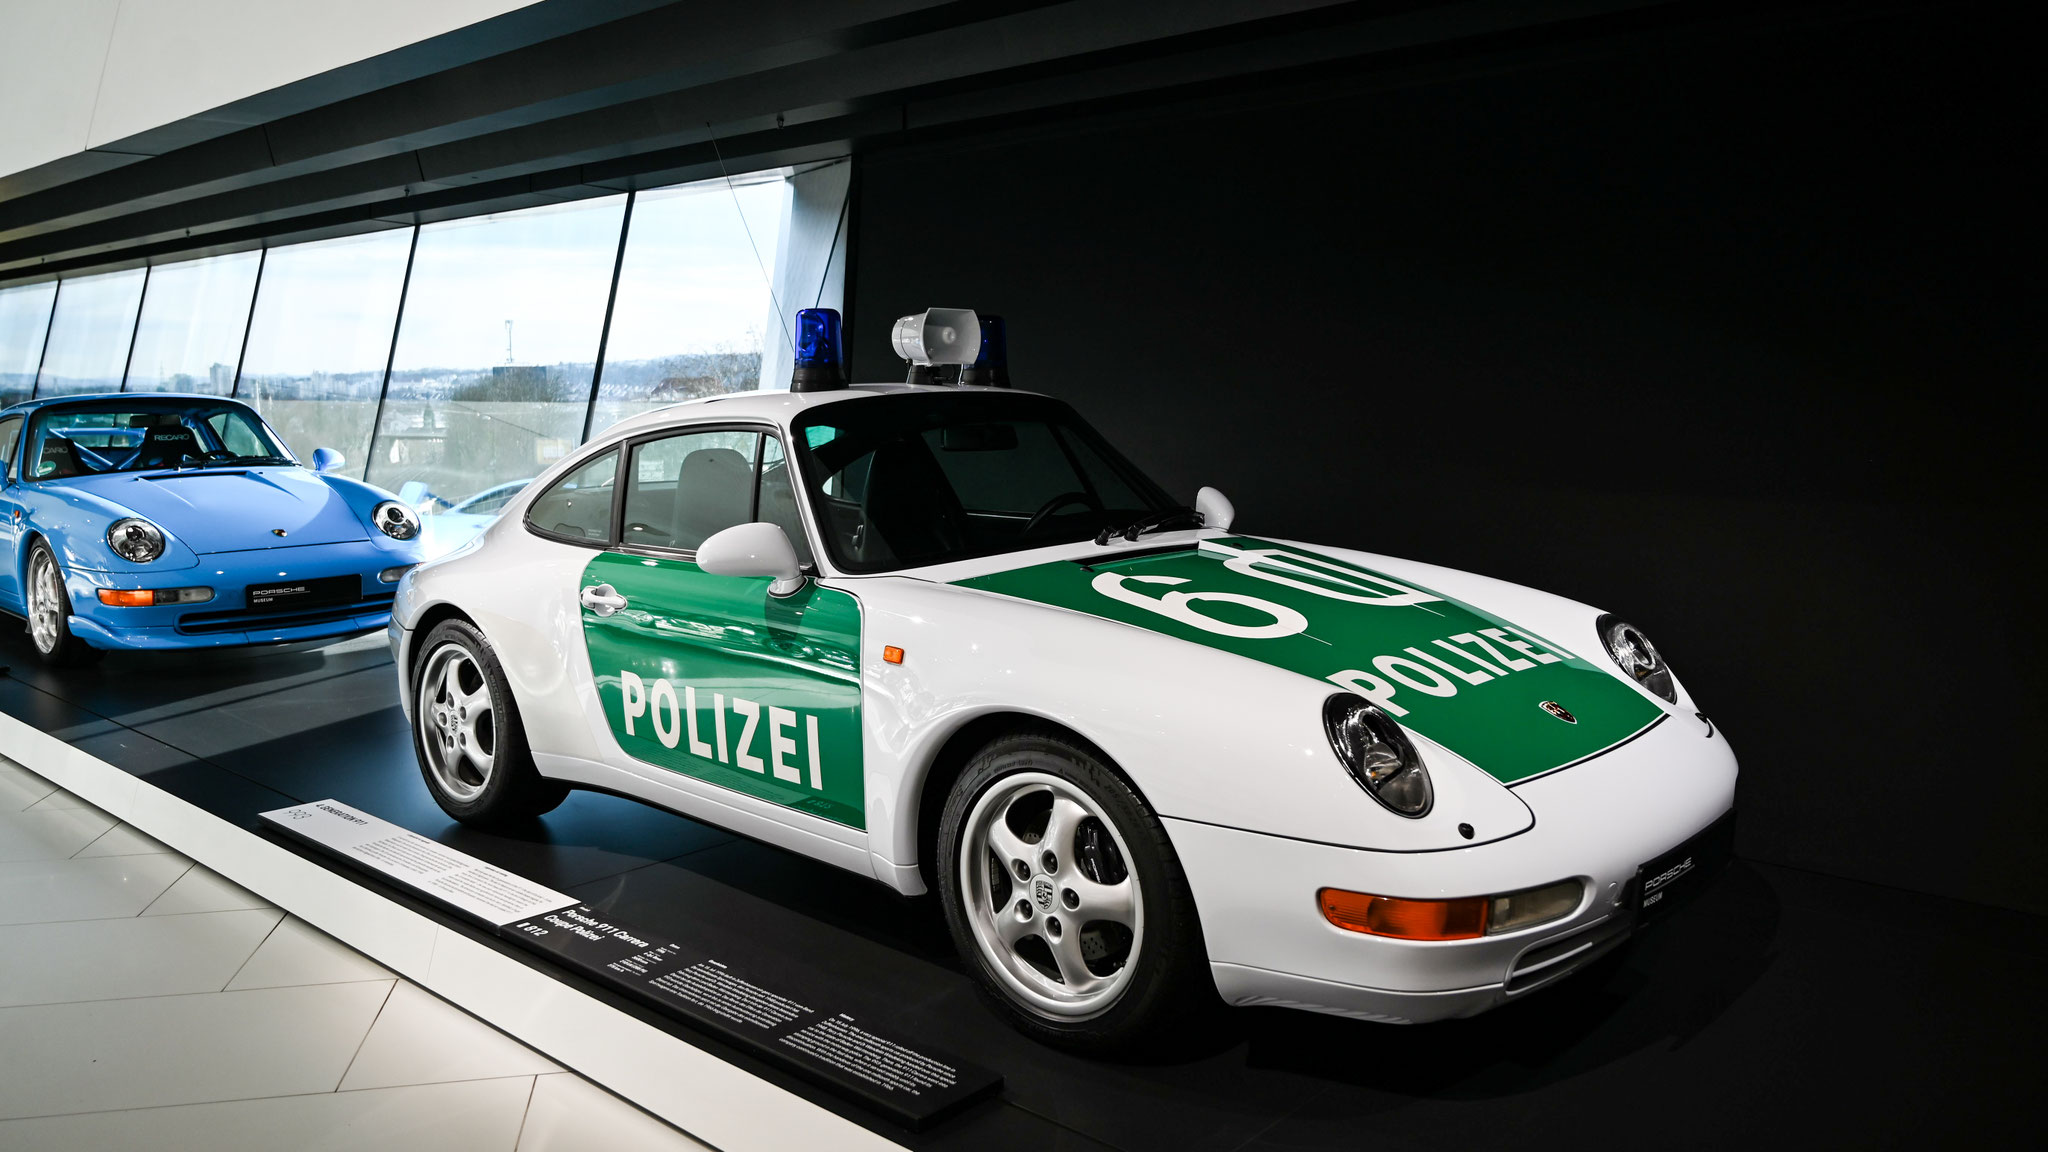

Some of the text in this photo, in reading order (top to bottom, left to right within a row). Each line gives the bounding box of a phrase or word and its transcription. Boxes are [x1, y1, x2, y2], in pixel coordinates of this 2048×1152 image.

[153, 433, 190, 441] RECARO
[43, 446, 69, 454] CARO
[252, 586, 305, 596] PORSCHE
[1325, 626, 1576, 718] POLIZEI
[620, 669, 823, 791] POLIZEI
[1644, 856, 1693, 891] PORSCHE
[1643, 891, 1663, 908] MUSEUM
[523, 925, 549, 936] 812
[544, 914, 606, 941] Coupé Polizei
[562, 909, 649, 948] Porsche 911 Carrera
